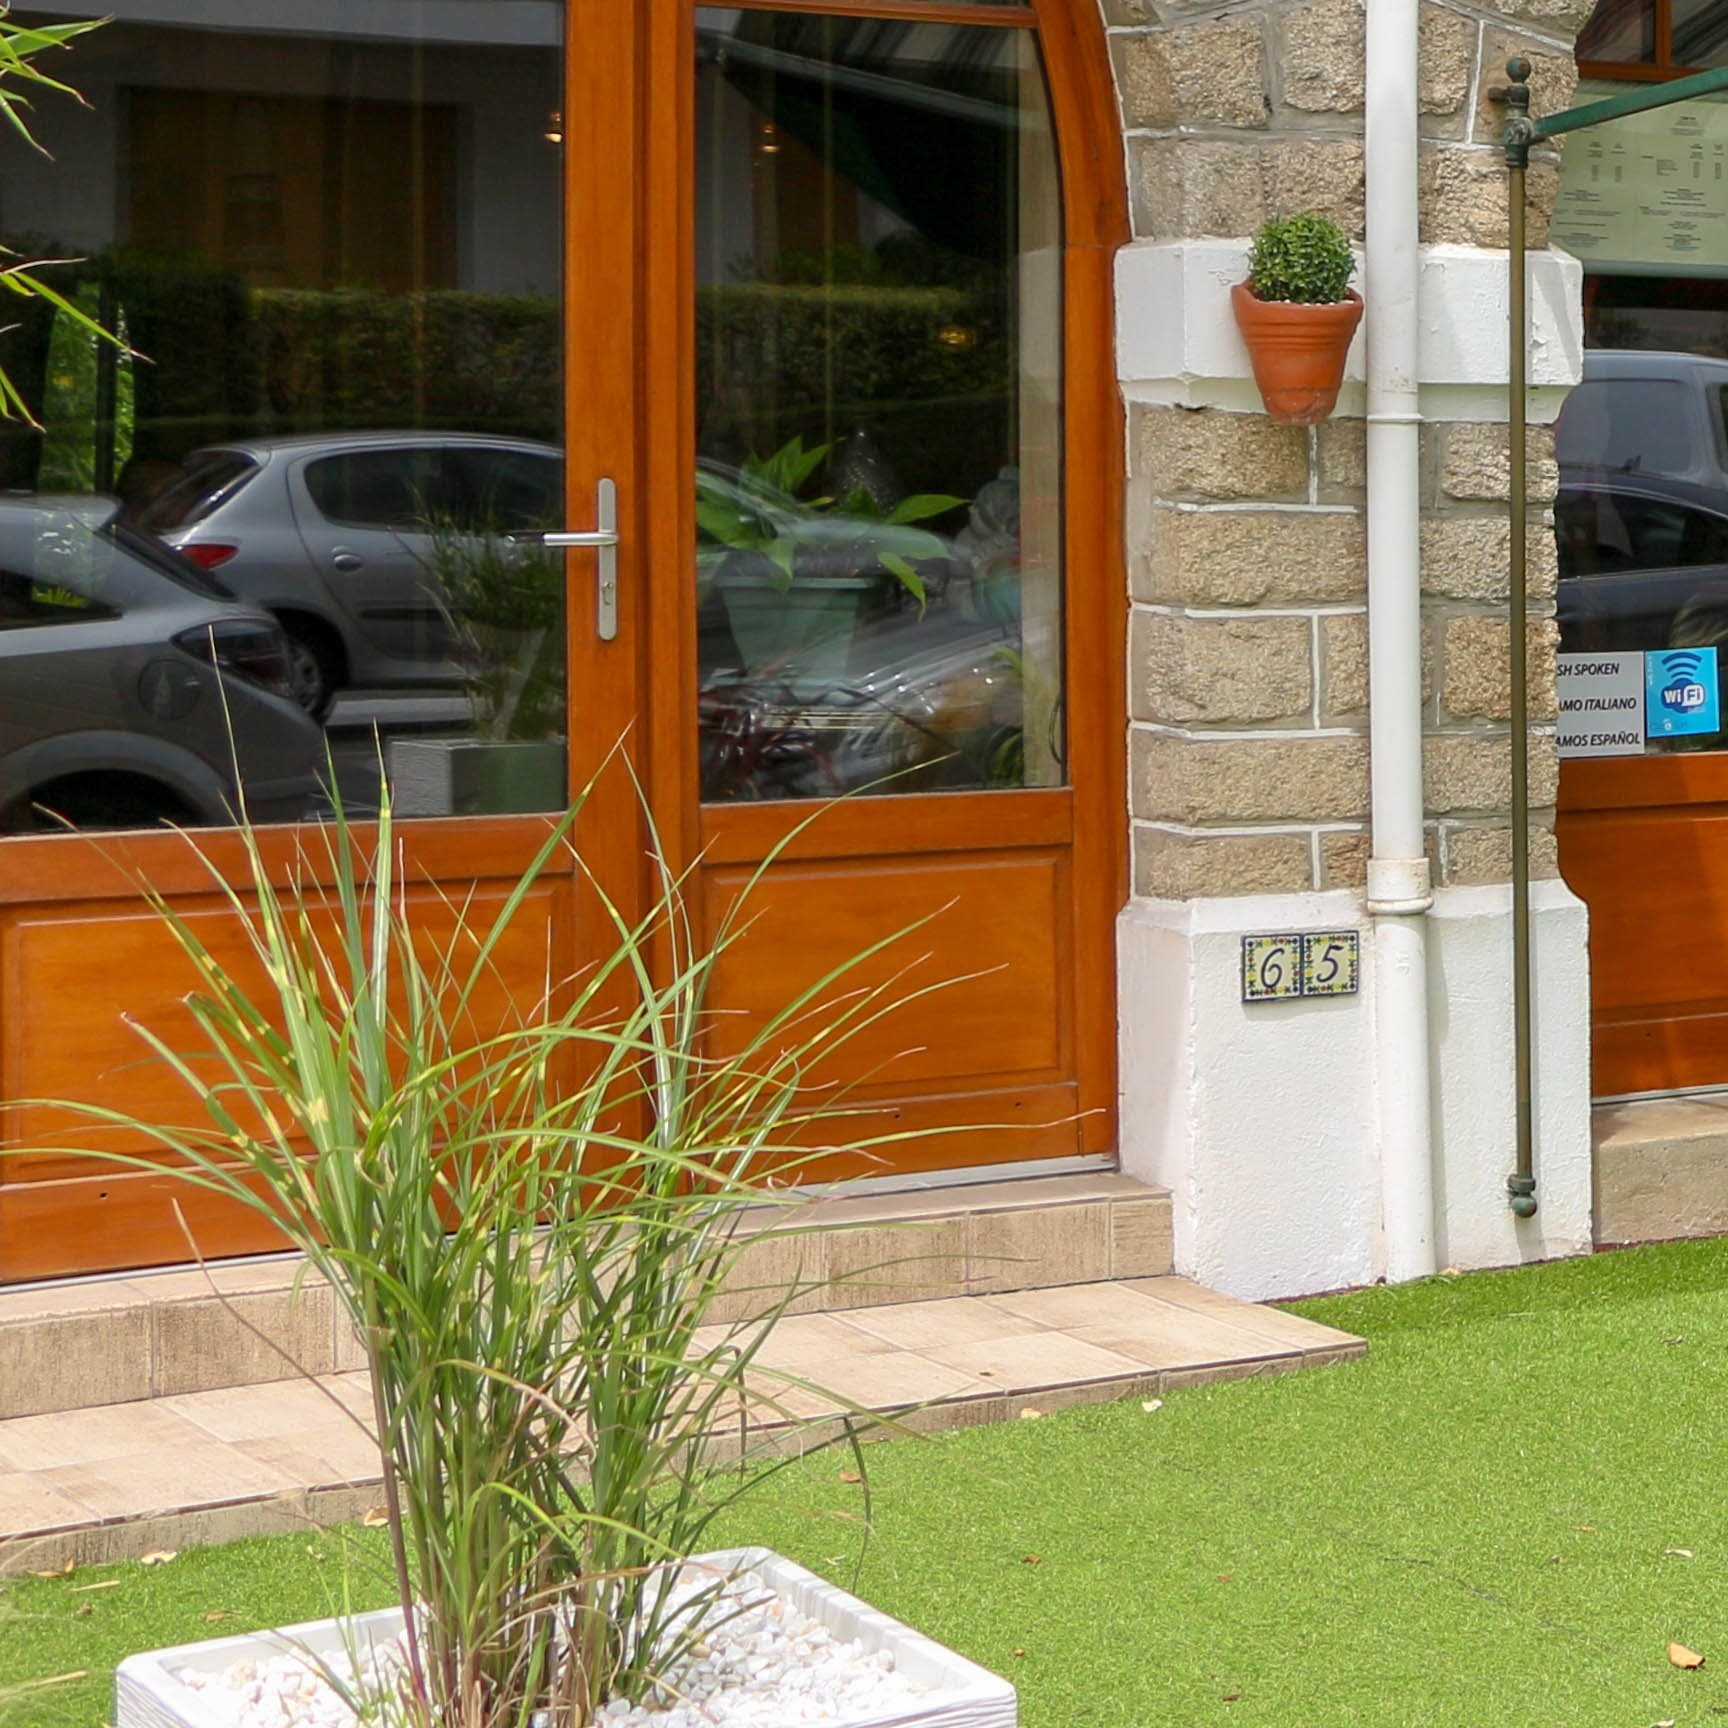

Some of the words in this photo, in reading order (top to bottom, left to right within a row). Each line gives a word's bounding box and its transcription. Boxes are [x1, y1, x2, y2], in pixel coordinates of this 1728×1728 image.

[1574, 662, 1620, 677] SPOKEN
[1584, 696, 1637, 712] ITALIANO
[1590, 729, 1641, 747] ESPAÑOL
[1260, 943, 1345, 990] 65
